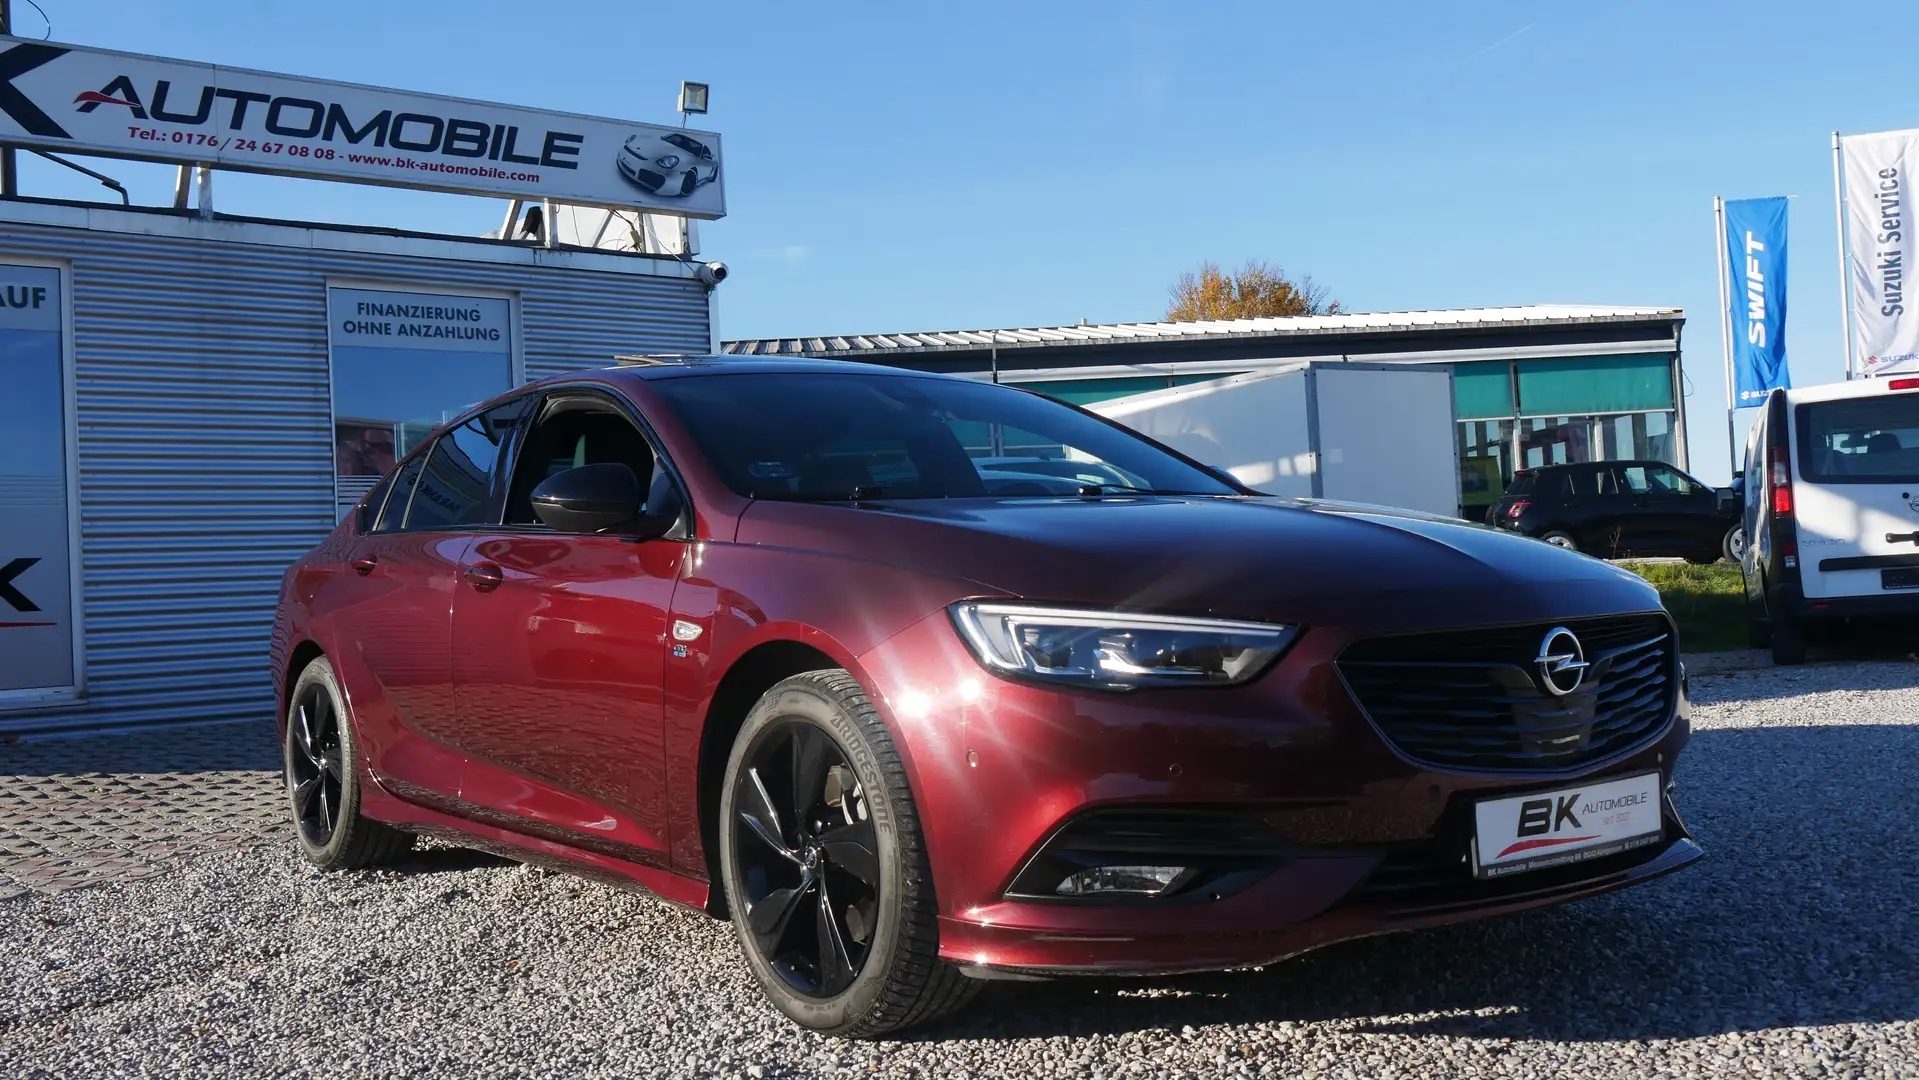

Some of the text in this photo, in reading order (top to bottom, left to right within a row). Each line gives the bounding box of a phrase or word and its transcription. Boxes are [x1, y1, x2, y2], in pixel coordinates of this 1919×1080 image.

[73, 75, 585, 170] AUTOMOBILE
[128, 126, 167, 142] Tel.:
[171, 131, 218, 147] 0176
[234, 138, 257, 152] 24
[261, 142, 283, 154] 67
[287, 145, 309, 157] 08
[313, 148, 335, 160] 08
[348, 152, 540, 183] www.bk-automobile.com
[1873, 167, 1904, 317] Suzuki Service
[0, 285, 46, 309] UF
[357, 302, 481, 322] FINANZIERUNG
[1746, 230, 1766, 348] SWIFT
[343, 320, 500, 341] OHNE ANZAHLUNG
[829, 710, 892, 834] BRIDGESTONE
[1517, 792, 1648, 838] BK AUTOMOBILE
